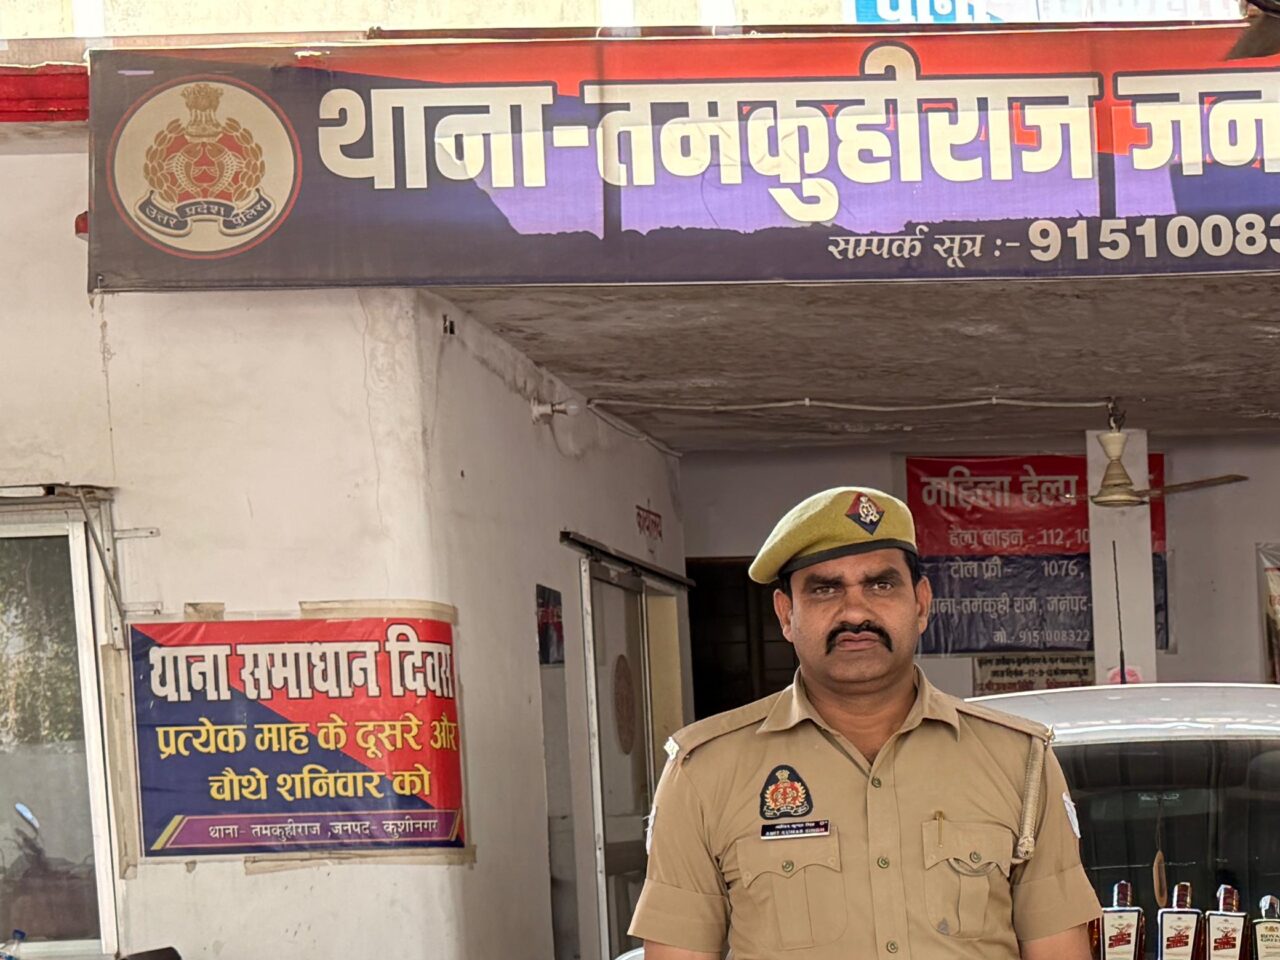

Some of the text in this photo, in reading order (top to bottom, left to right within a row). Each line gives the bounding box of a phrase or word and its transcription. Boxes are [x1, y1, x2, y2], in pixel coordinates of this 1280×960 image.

[318, 41, 1099, 223] थाना-तमकुहीराज
[146, 200, 267, 228] उत्तर प्रदेश पुलिस
[827, 224, 928, 261] सम्पर्क
[933, 233, 983, 268] सूत्र
[921, 465, 1011, 510] महिला
[150, 645, 231, 702] थाना
[236, 641, 380, 699] समाधान
[156, 718, 247, 759] प्रत्येक
[254, 724, 309, 755] माह
[317, 714, 347, 751] के
[355, 714, 422, 758] दूसरे
[208, 764, 431, 801] चौथे शनिवार को
